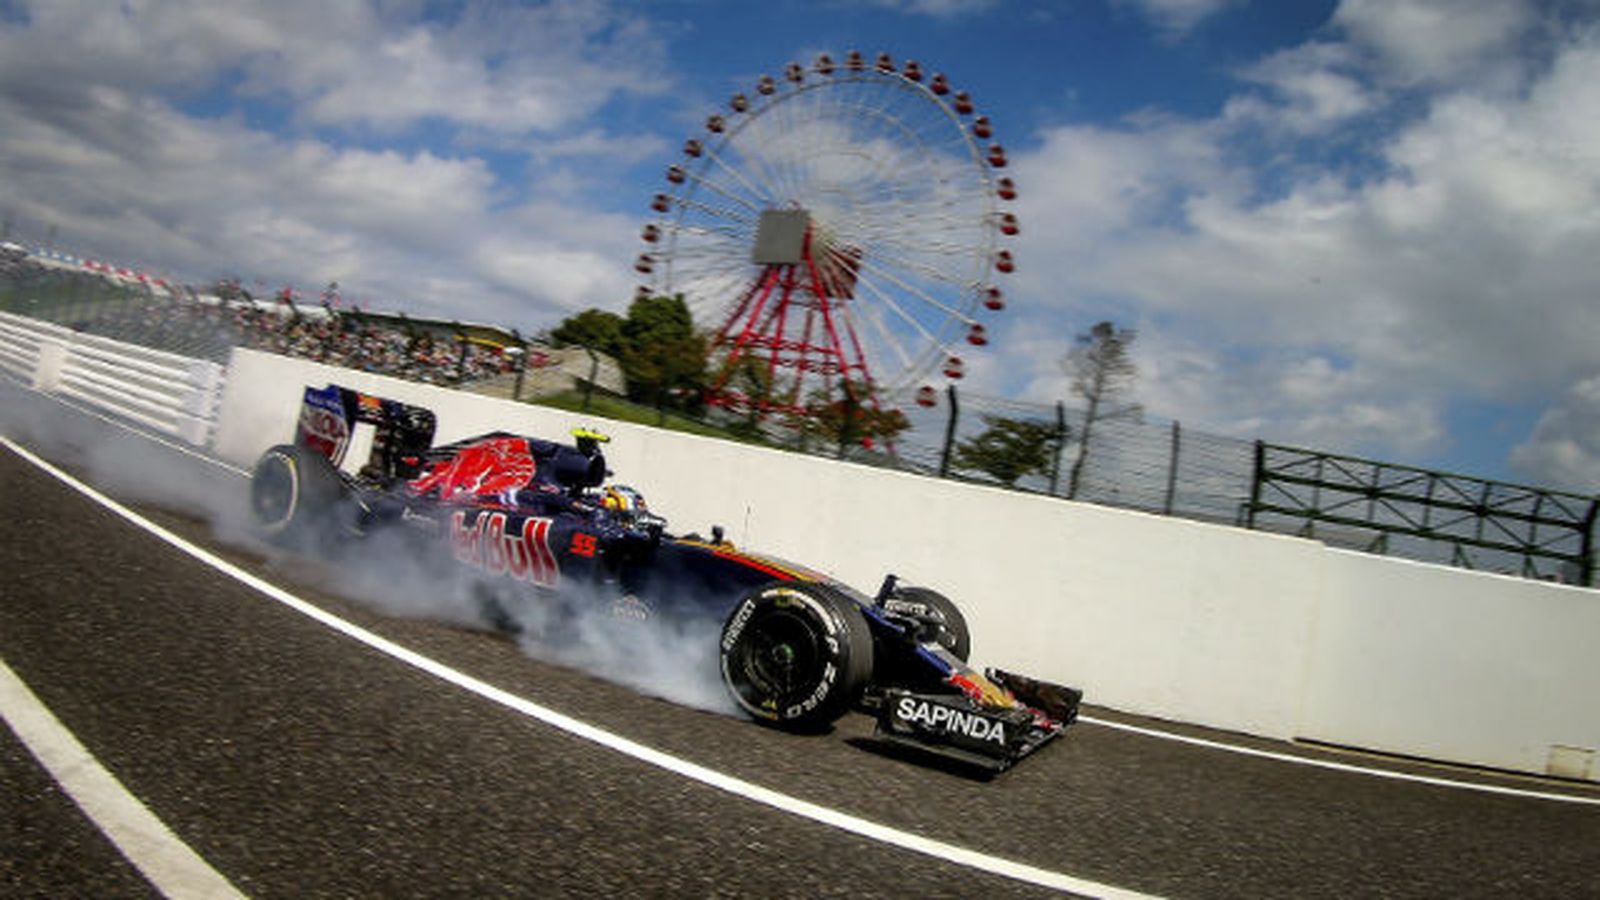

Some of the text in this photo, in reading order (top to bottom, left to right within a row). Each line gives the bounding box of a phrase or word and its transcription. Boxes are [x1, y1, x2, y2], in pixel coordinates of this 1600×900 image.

[452, 511, 560, 588] Red Bull
[569, 533, 598, 558] 55
[897, 698, 1005, 745] SAPINDA
